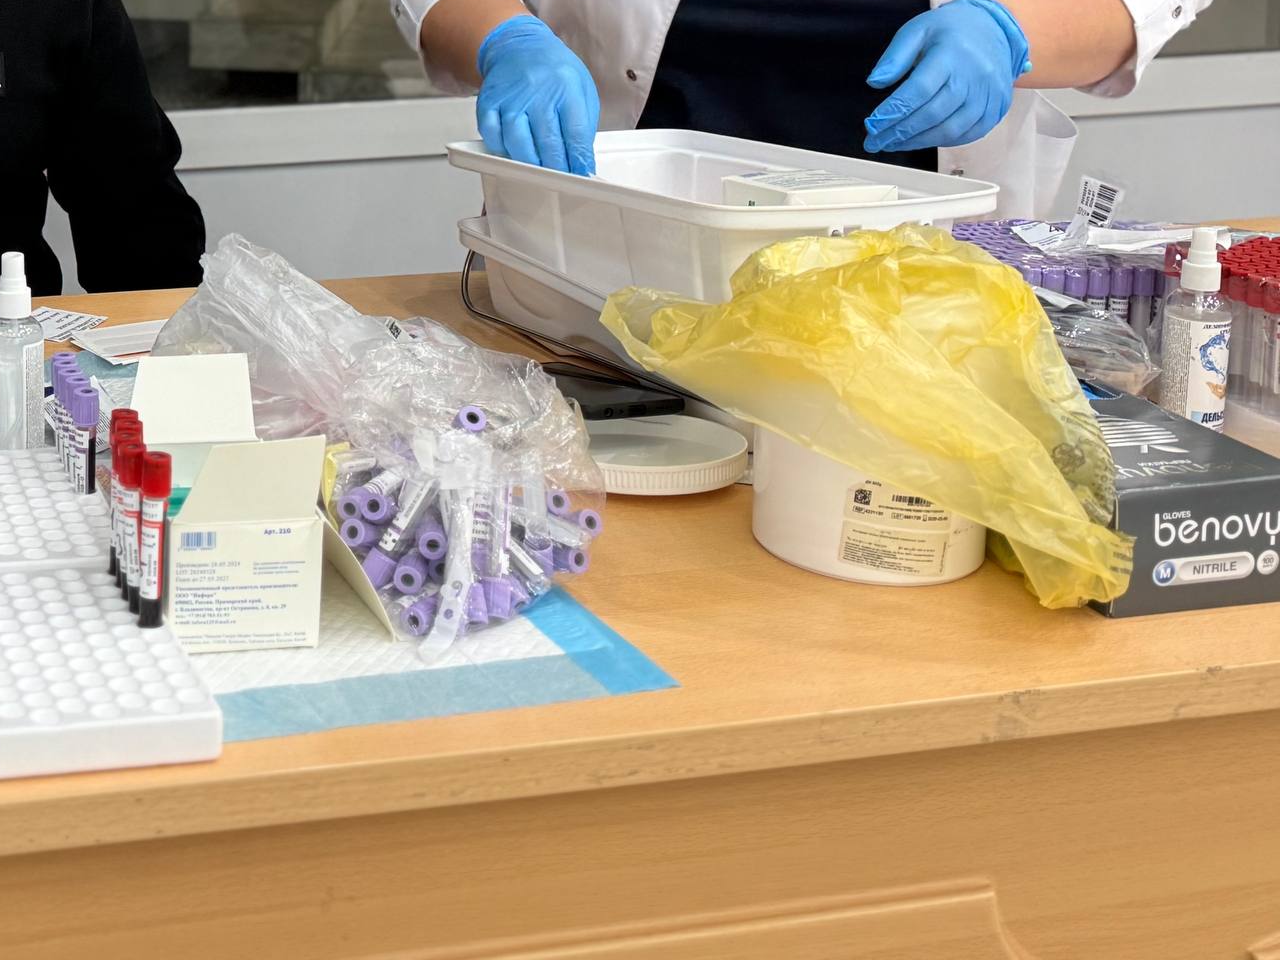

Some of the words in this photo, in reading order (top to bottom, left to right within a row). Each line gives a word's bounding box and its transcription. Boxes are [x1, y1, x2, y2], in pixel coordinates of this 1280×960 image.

[1162, 510, 1192, 520] GLOVES
[1154, 511, 1280, 547] benovy
[1159, 567, 1171, 579] M
[1192, 561, 1238, 576] NITRILE
